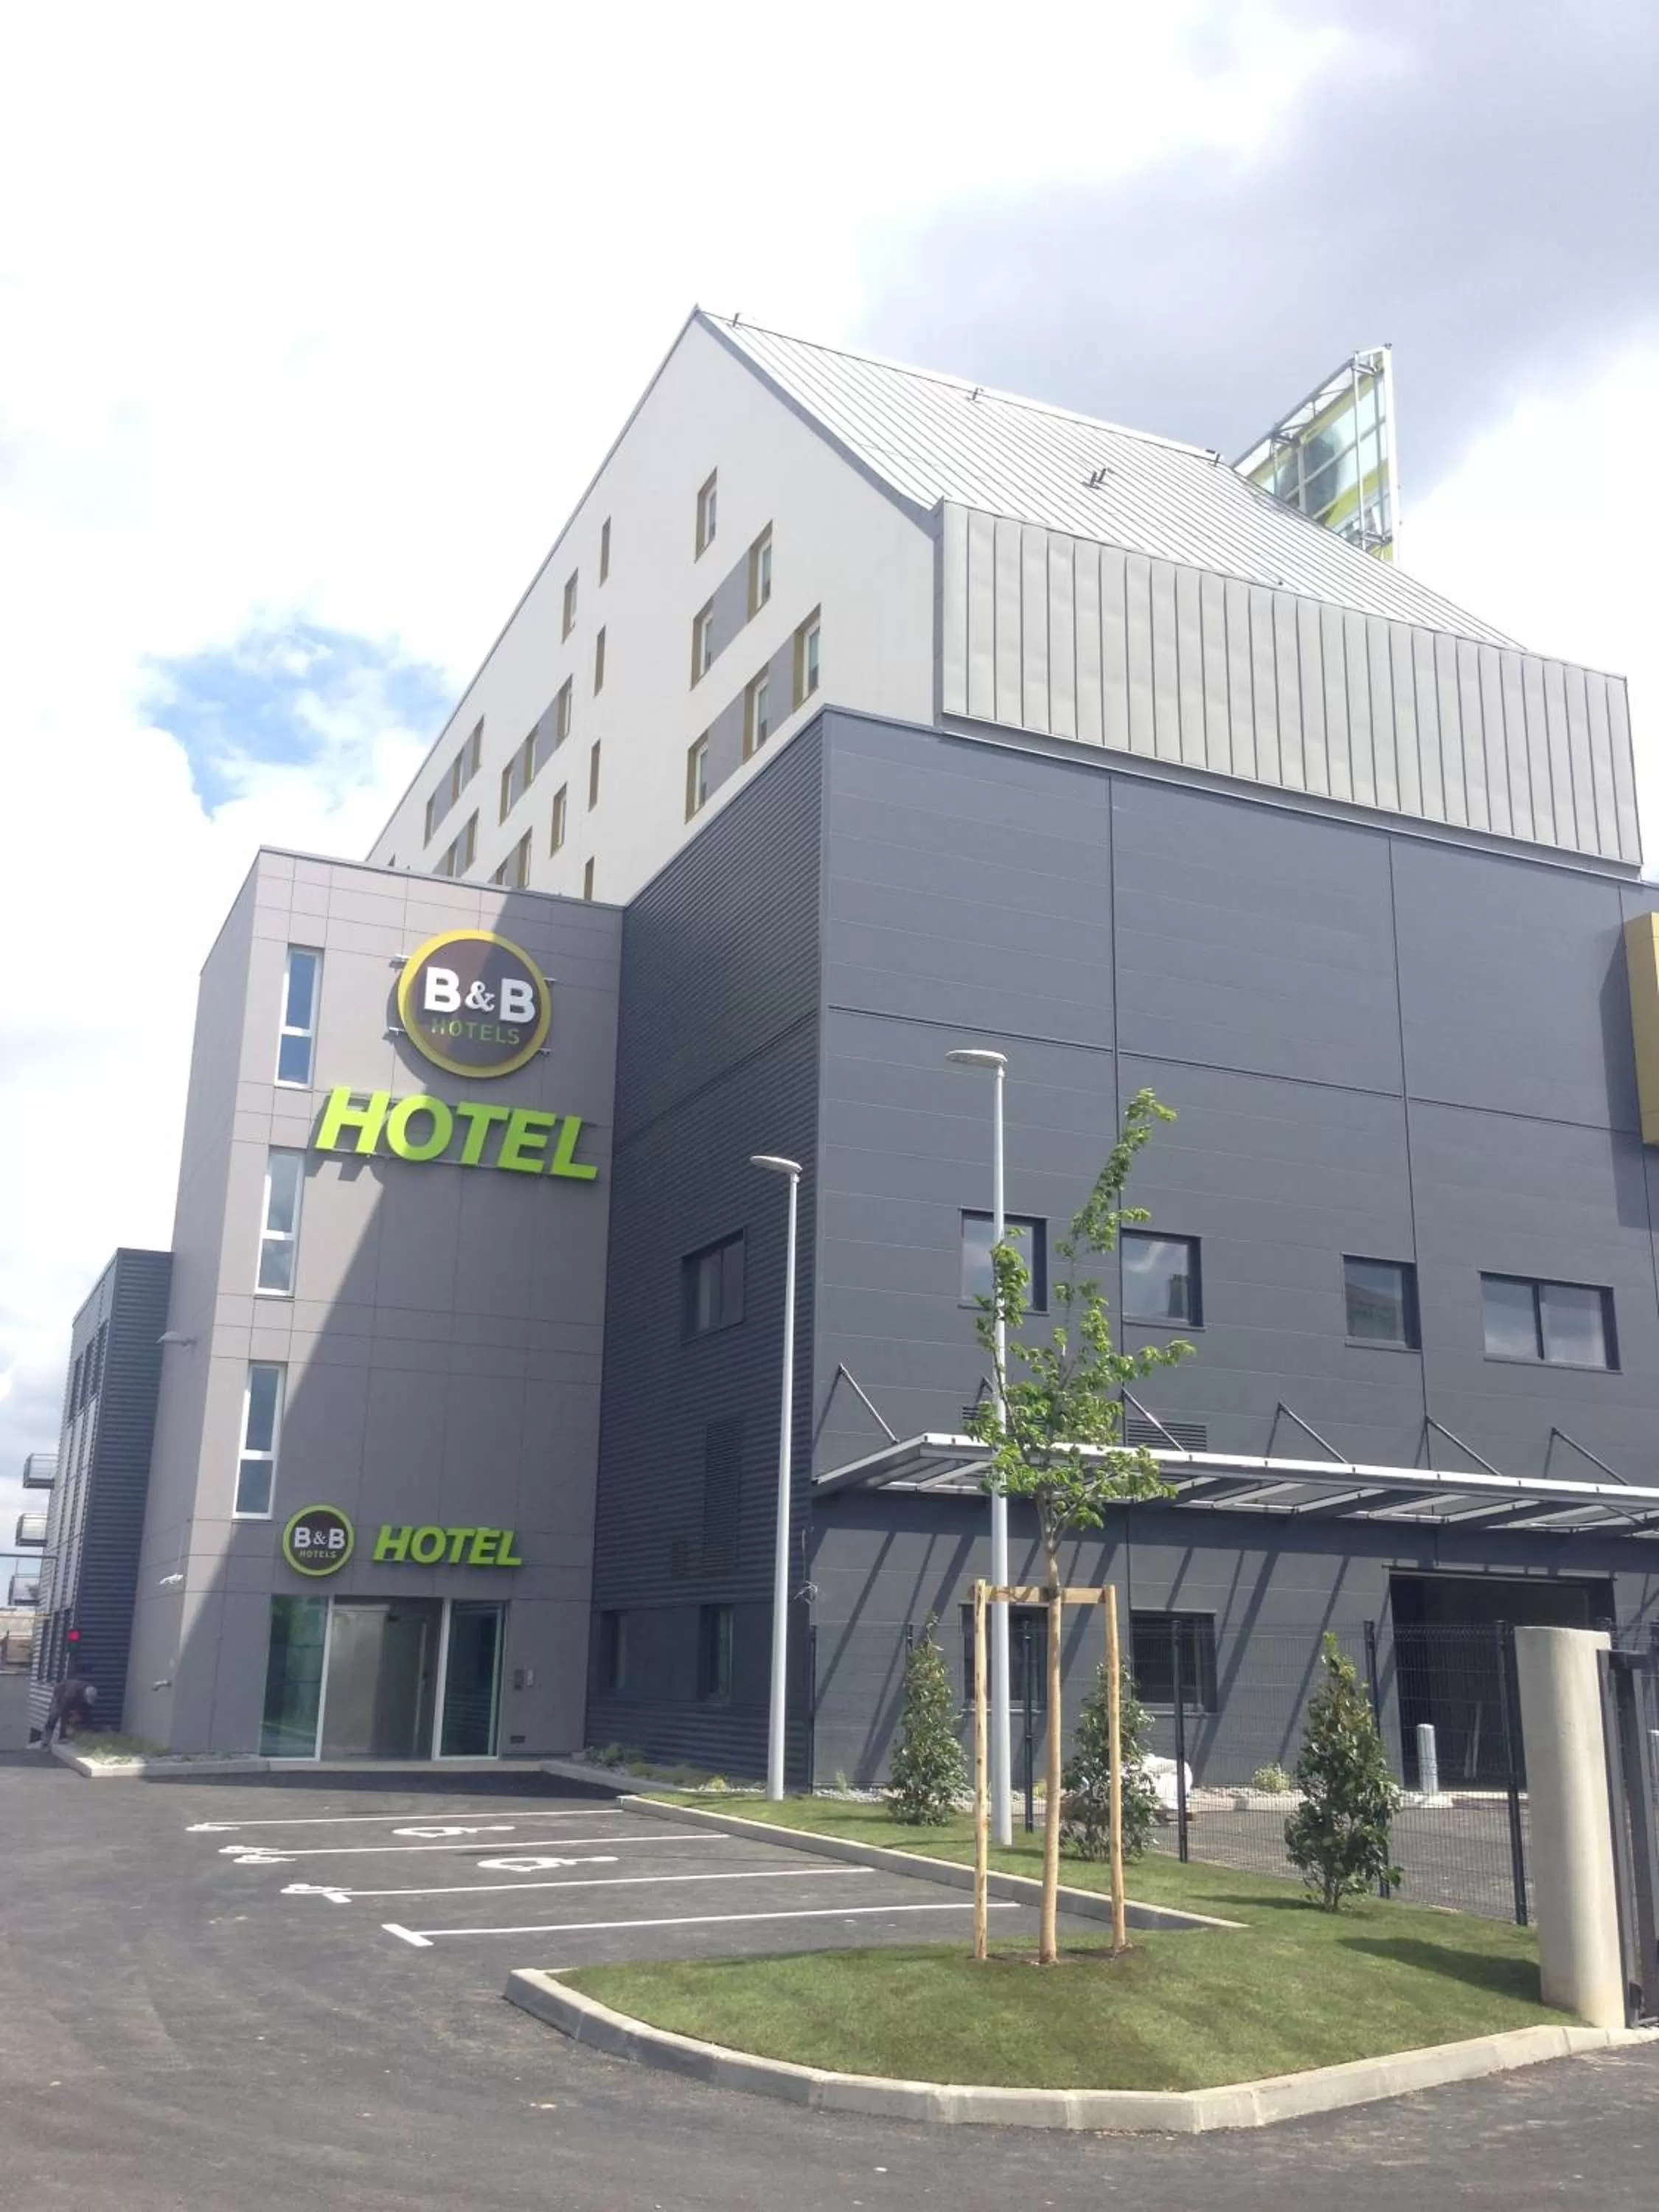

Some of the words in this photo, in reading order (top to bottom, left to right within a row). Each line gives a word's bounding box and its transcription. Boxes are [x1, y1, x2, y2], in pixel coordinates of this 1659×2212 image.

[423, 966, 536, 1023] B&B
[431, 1018, 521, 1046] HOTELS
[315, 1085, 598, 1180] HOTEL
[294, 1526, 345, 1550] B&B
[299, 1549, 338, 1559] HOTELS
[372, 1524, 522, 1566] HOTEL
